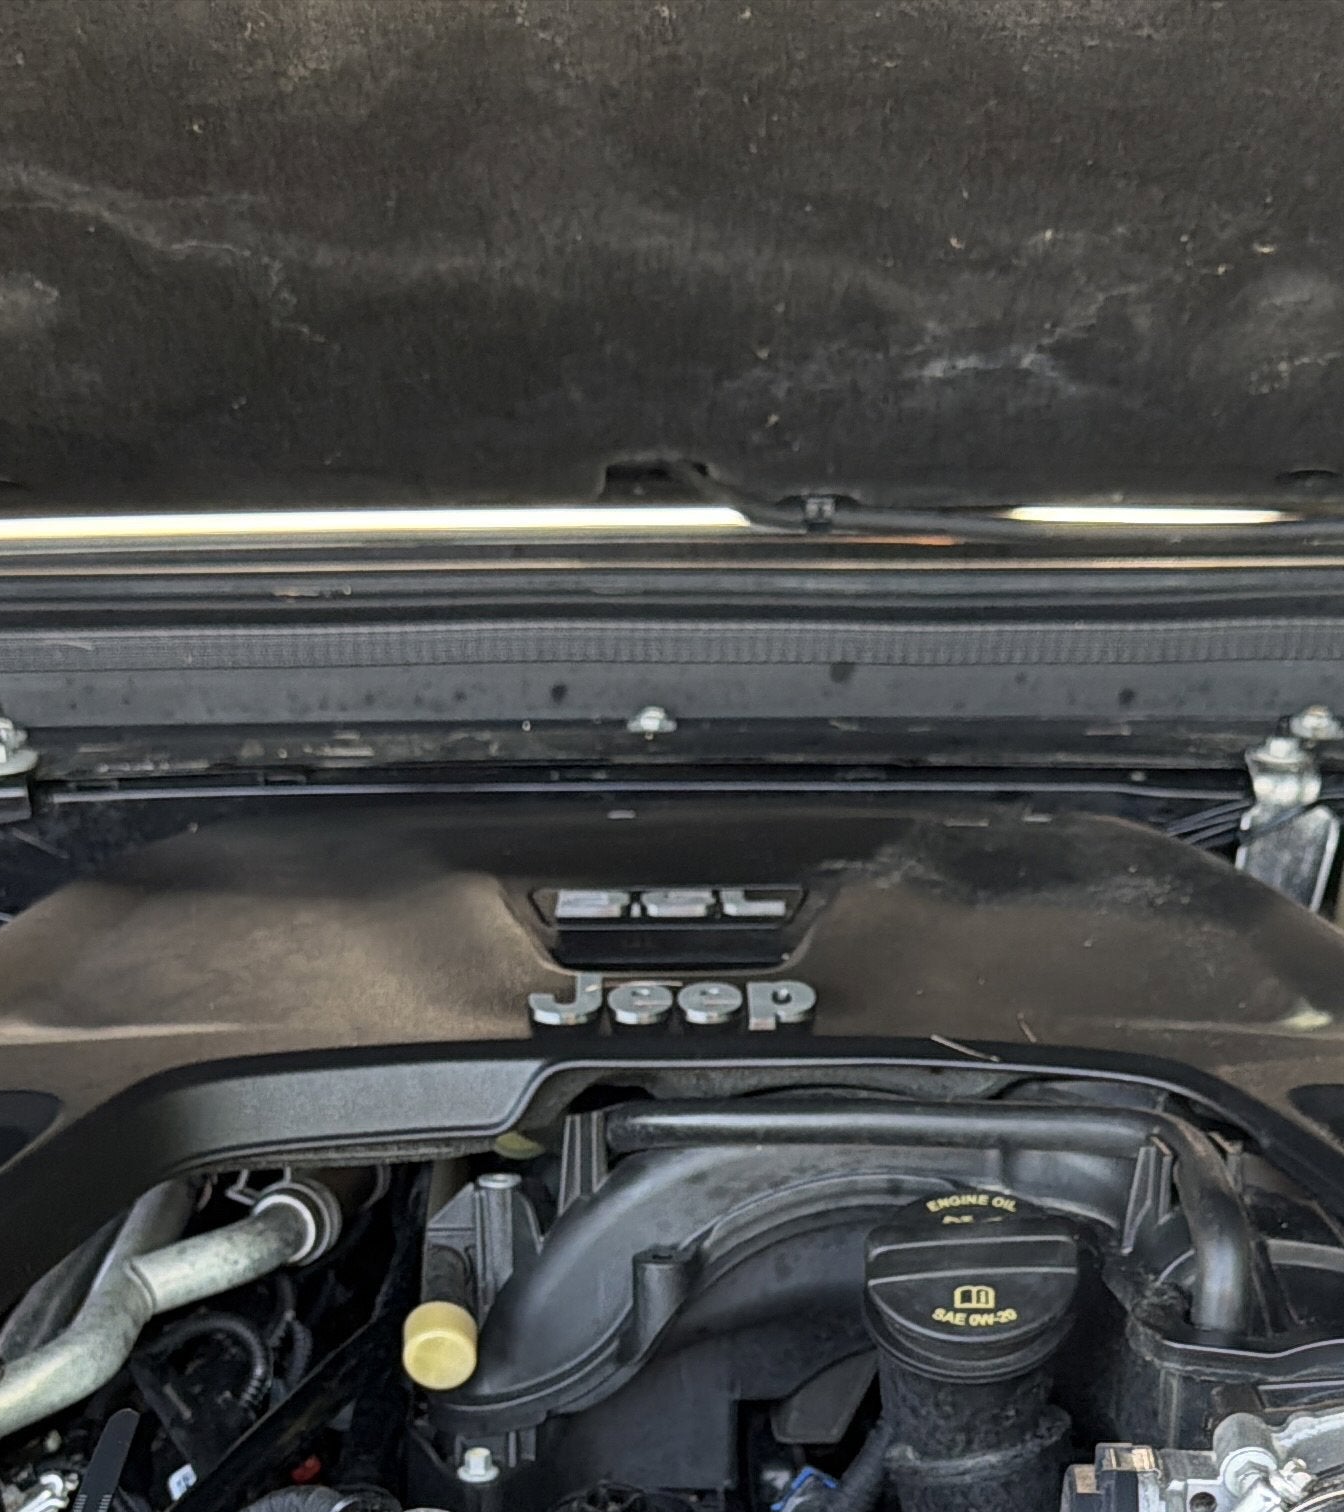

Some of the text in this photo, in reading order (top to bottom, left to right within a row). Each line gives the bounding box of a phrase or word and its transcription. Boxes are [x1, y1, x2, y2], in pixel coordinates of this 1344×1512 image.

[528, 972, 817, 1031] Jeep
[926, 1194, 1017, 1213] ENGINE OIL
[931, 1308, 966, 1326] SAE
